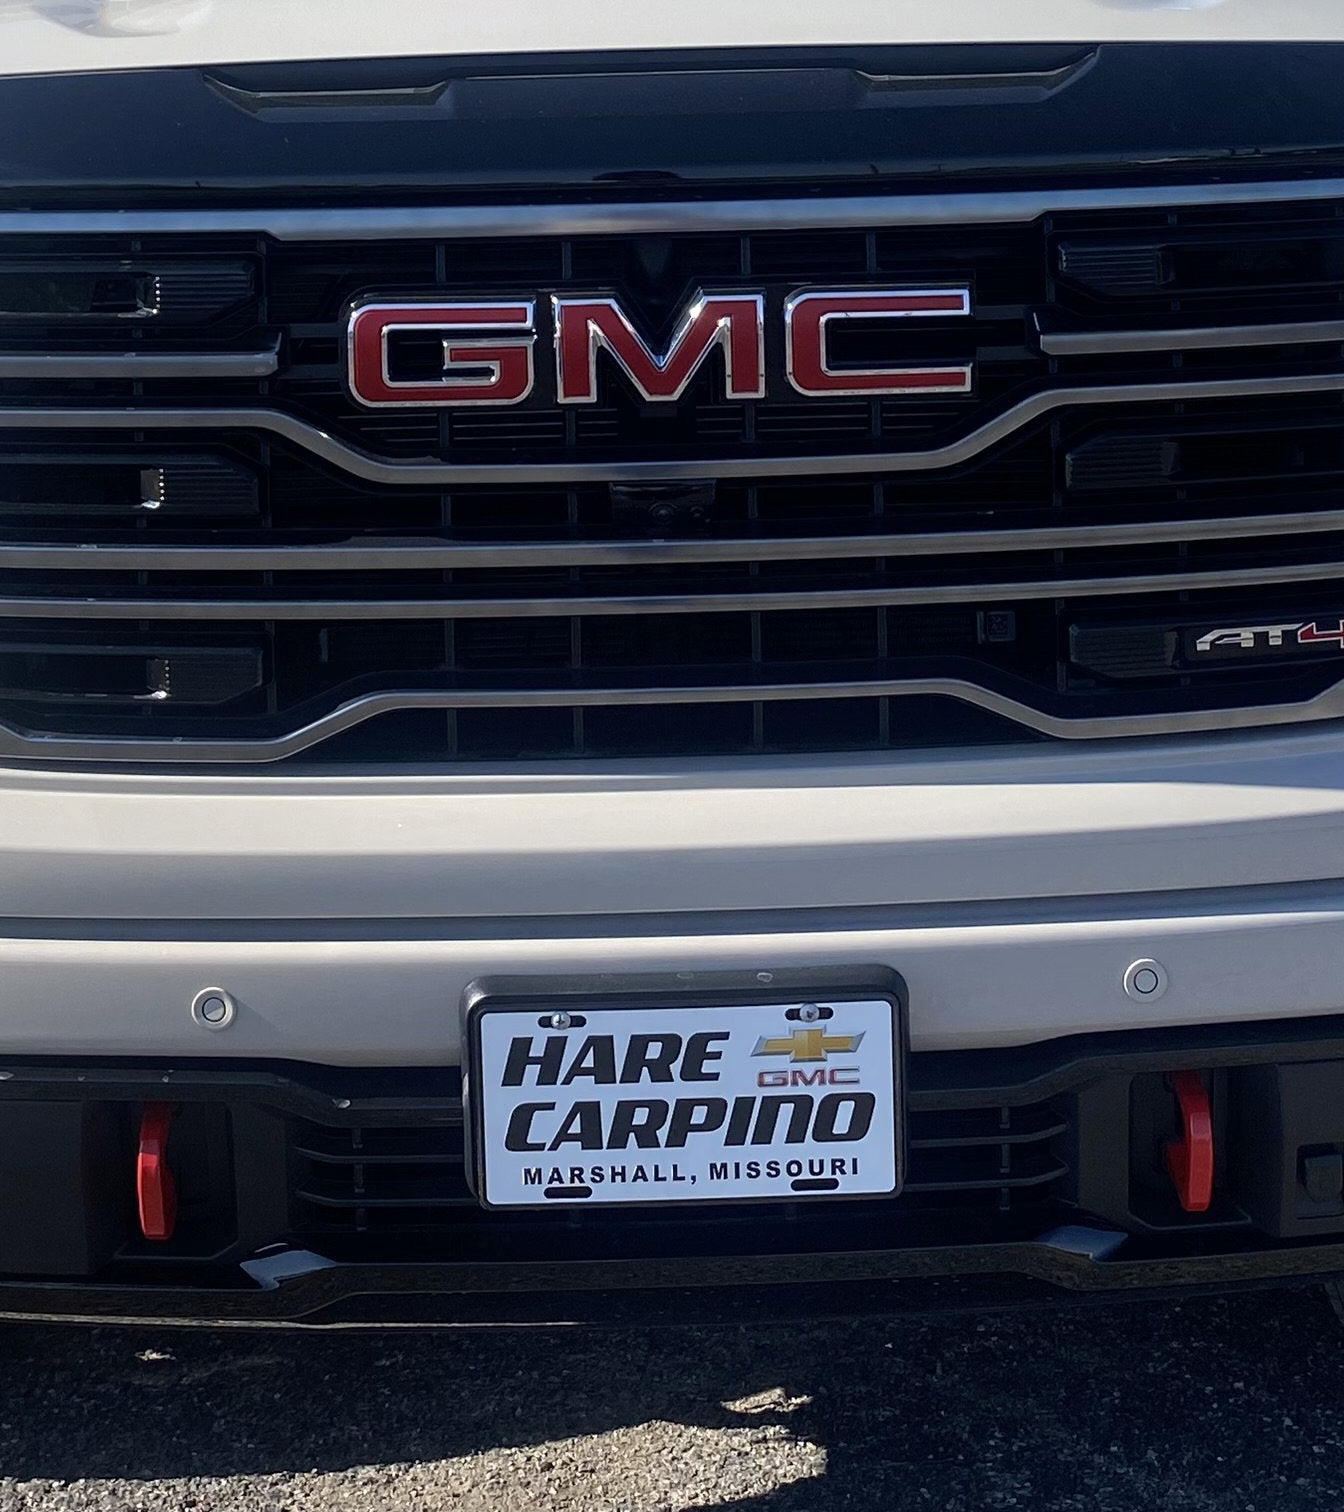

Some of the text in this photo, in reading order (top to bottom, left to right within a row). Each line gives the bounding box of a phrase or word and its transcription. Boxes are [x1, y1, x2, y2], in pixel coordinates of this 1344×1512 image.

[348, 287, 972, 409] GMC
[501, 1031, 731, 1087] HARE
[757, 1065, 862, 1088] GMC
[504, 1092, 877, 1152] CARPINO
[523, 1157, 859, 1185] MARSHALL, MISSOURI
